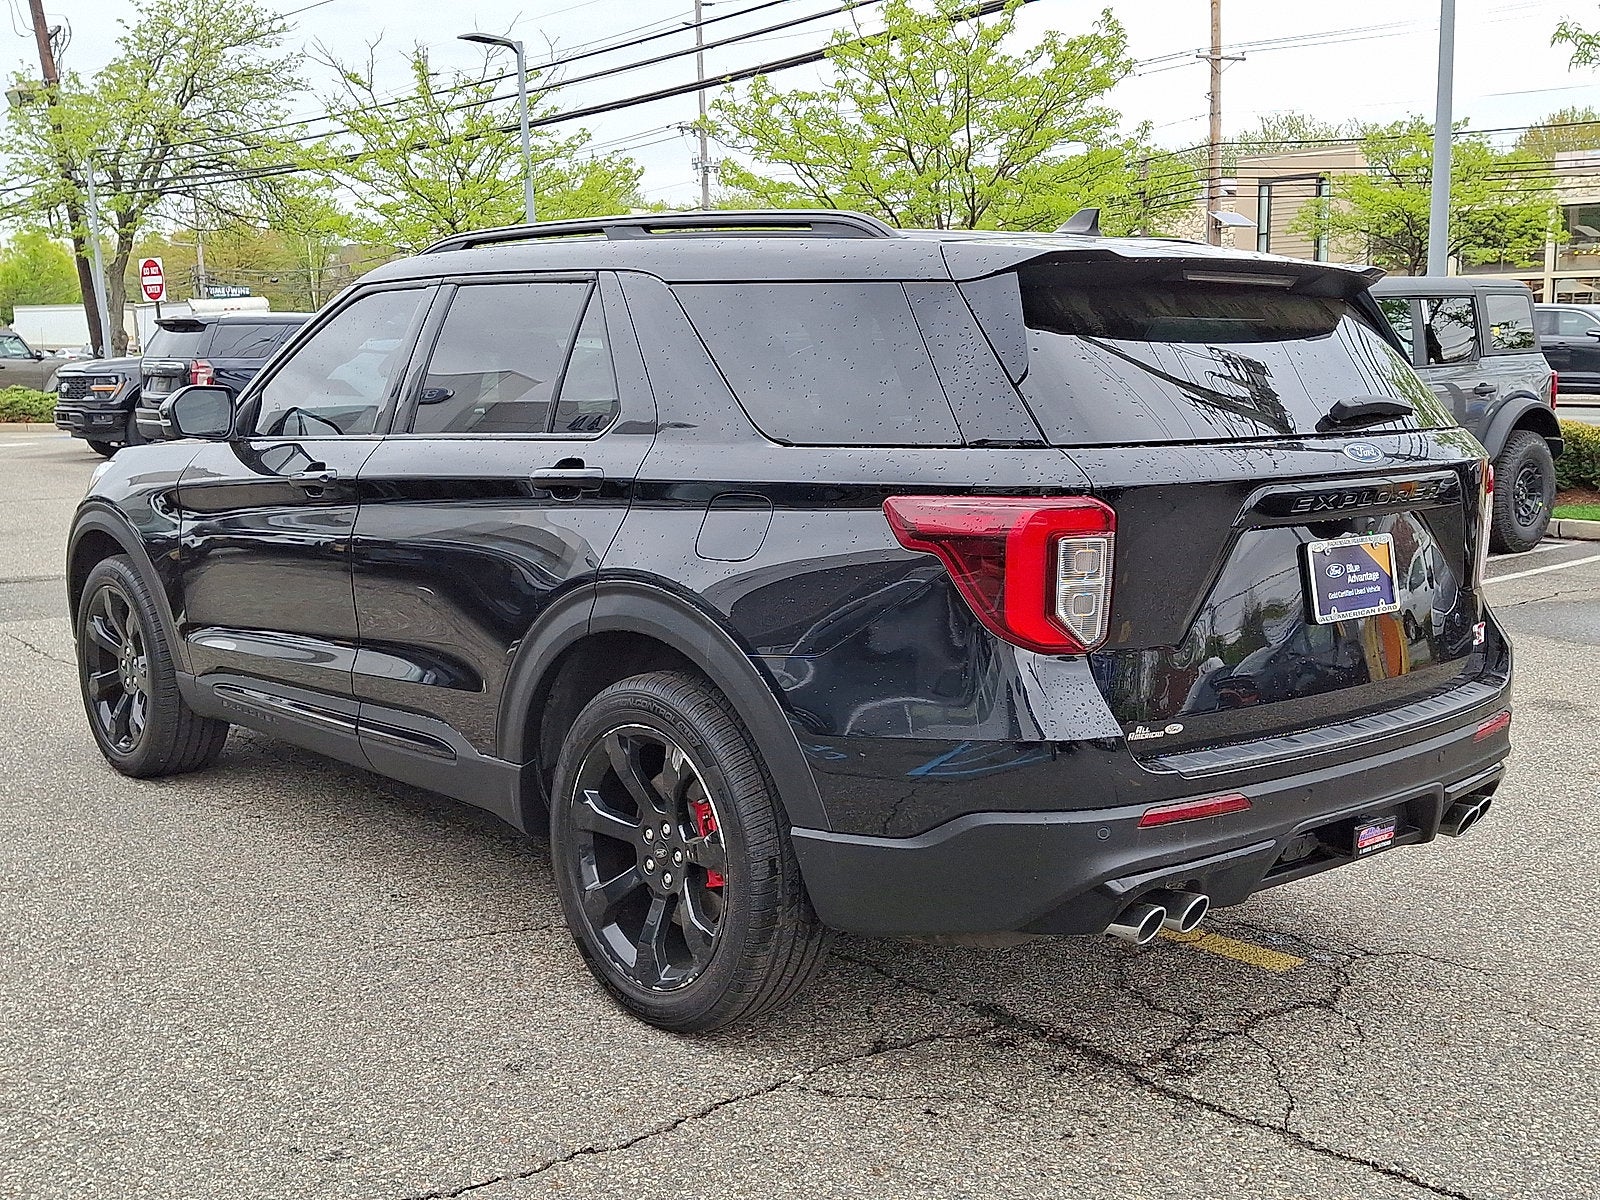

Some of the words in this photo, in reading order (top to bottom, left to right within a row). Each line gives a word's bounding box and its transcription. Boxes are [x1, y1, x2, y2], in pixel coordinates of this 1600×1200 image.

[150, 266, 159, 275] NOT
[146, 285, 161, 294] ENTER
[1291, 486, 1440, 512] EXPLORER
[1346, 564, 1361, 574] Blue
[1347, 571, 1380, 584] Advantage
[1336, 608, 1376, 620] AMERICAN
[1377, 604, 1398, 613] FORD
